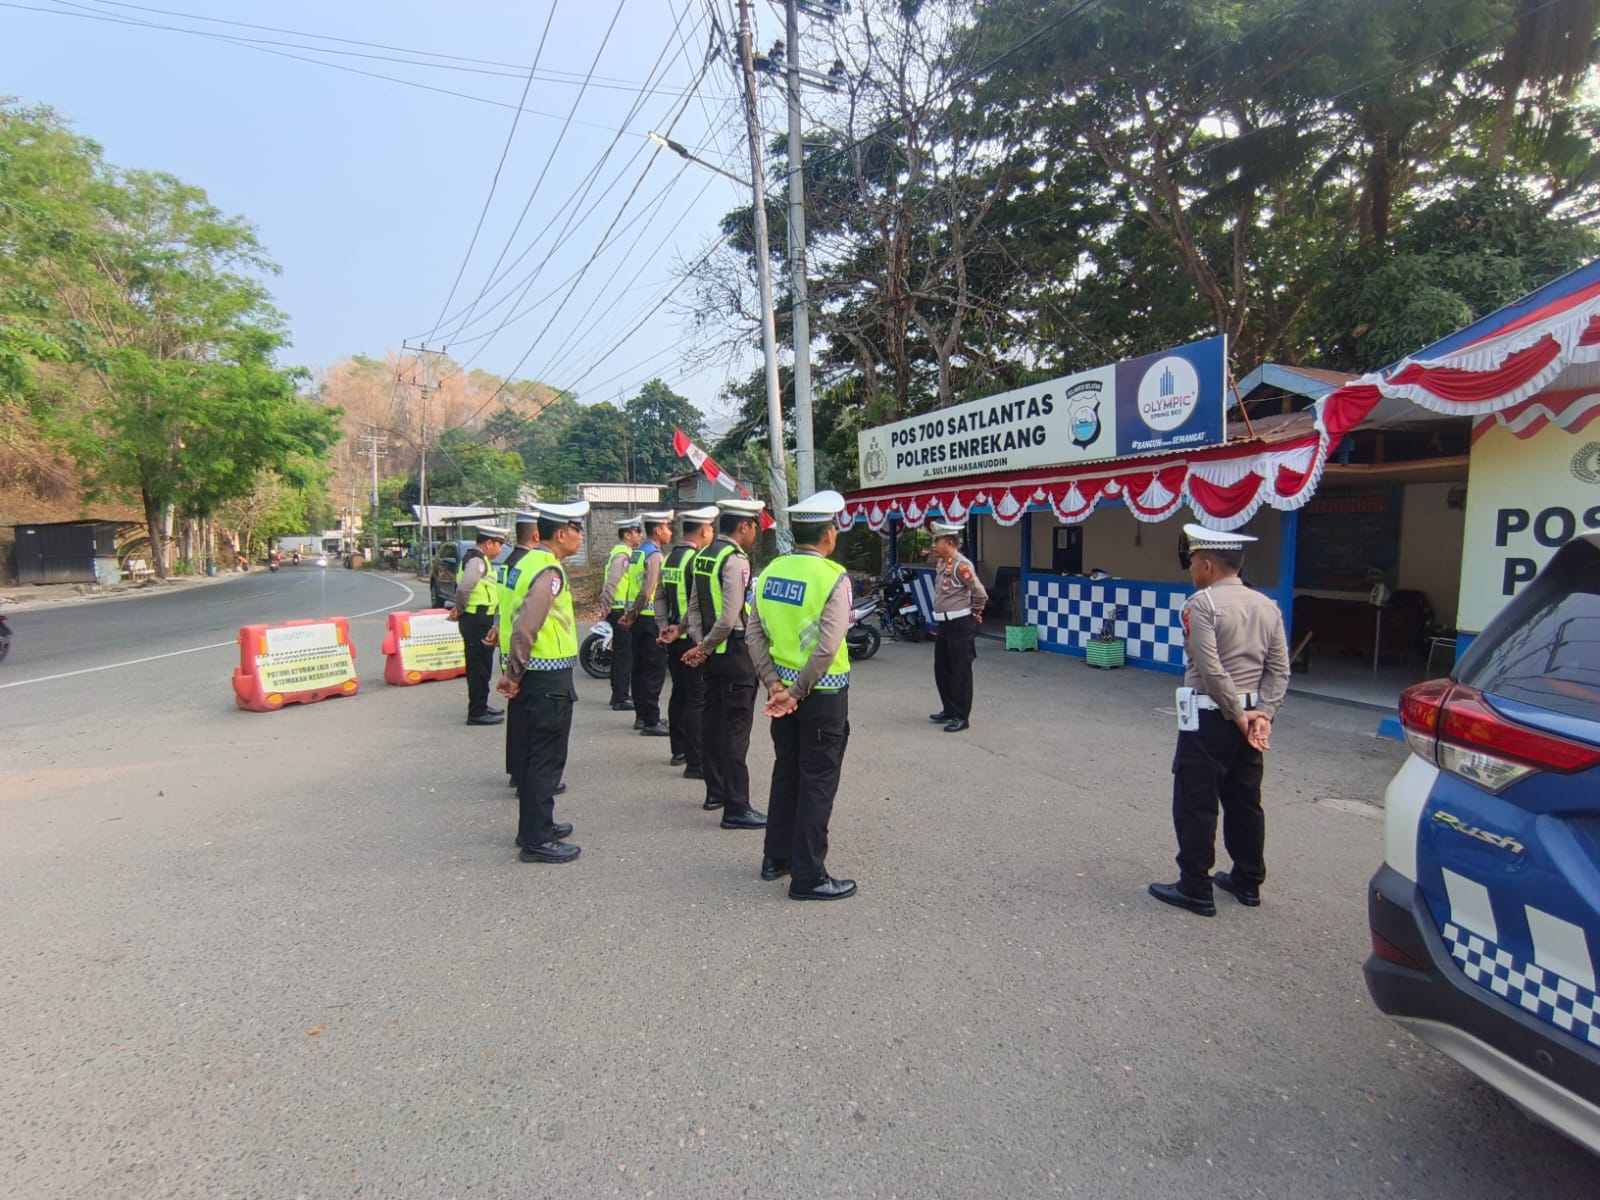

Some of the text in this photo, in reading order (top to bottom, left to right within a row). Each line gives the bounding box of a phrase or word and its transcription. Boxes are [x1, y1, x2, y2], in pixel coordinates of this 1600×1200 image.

[1143, 395, 1191, 414] OLYMPIC
[1150, 409, 1183, 420] SPRING BED
[890, 393, 1054, 448] POS 700 SATLANTAS
[896, 425, 1046, 469] POLRES ENREKANG
[923, 457, 1008, 477] JL. SULTAN HASANUDDIN
[763, 580, 804, 602] POLISI
[1432, 810, 1524, 854] Rush
